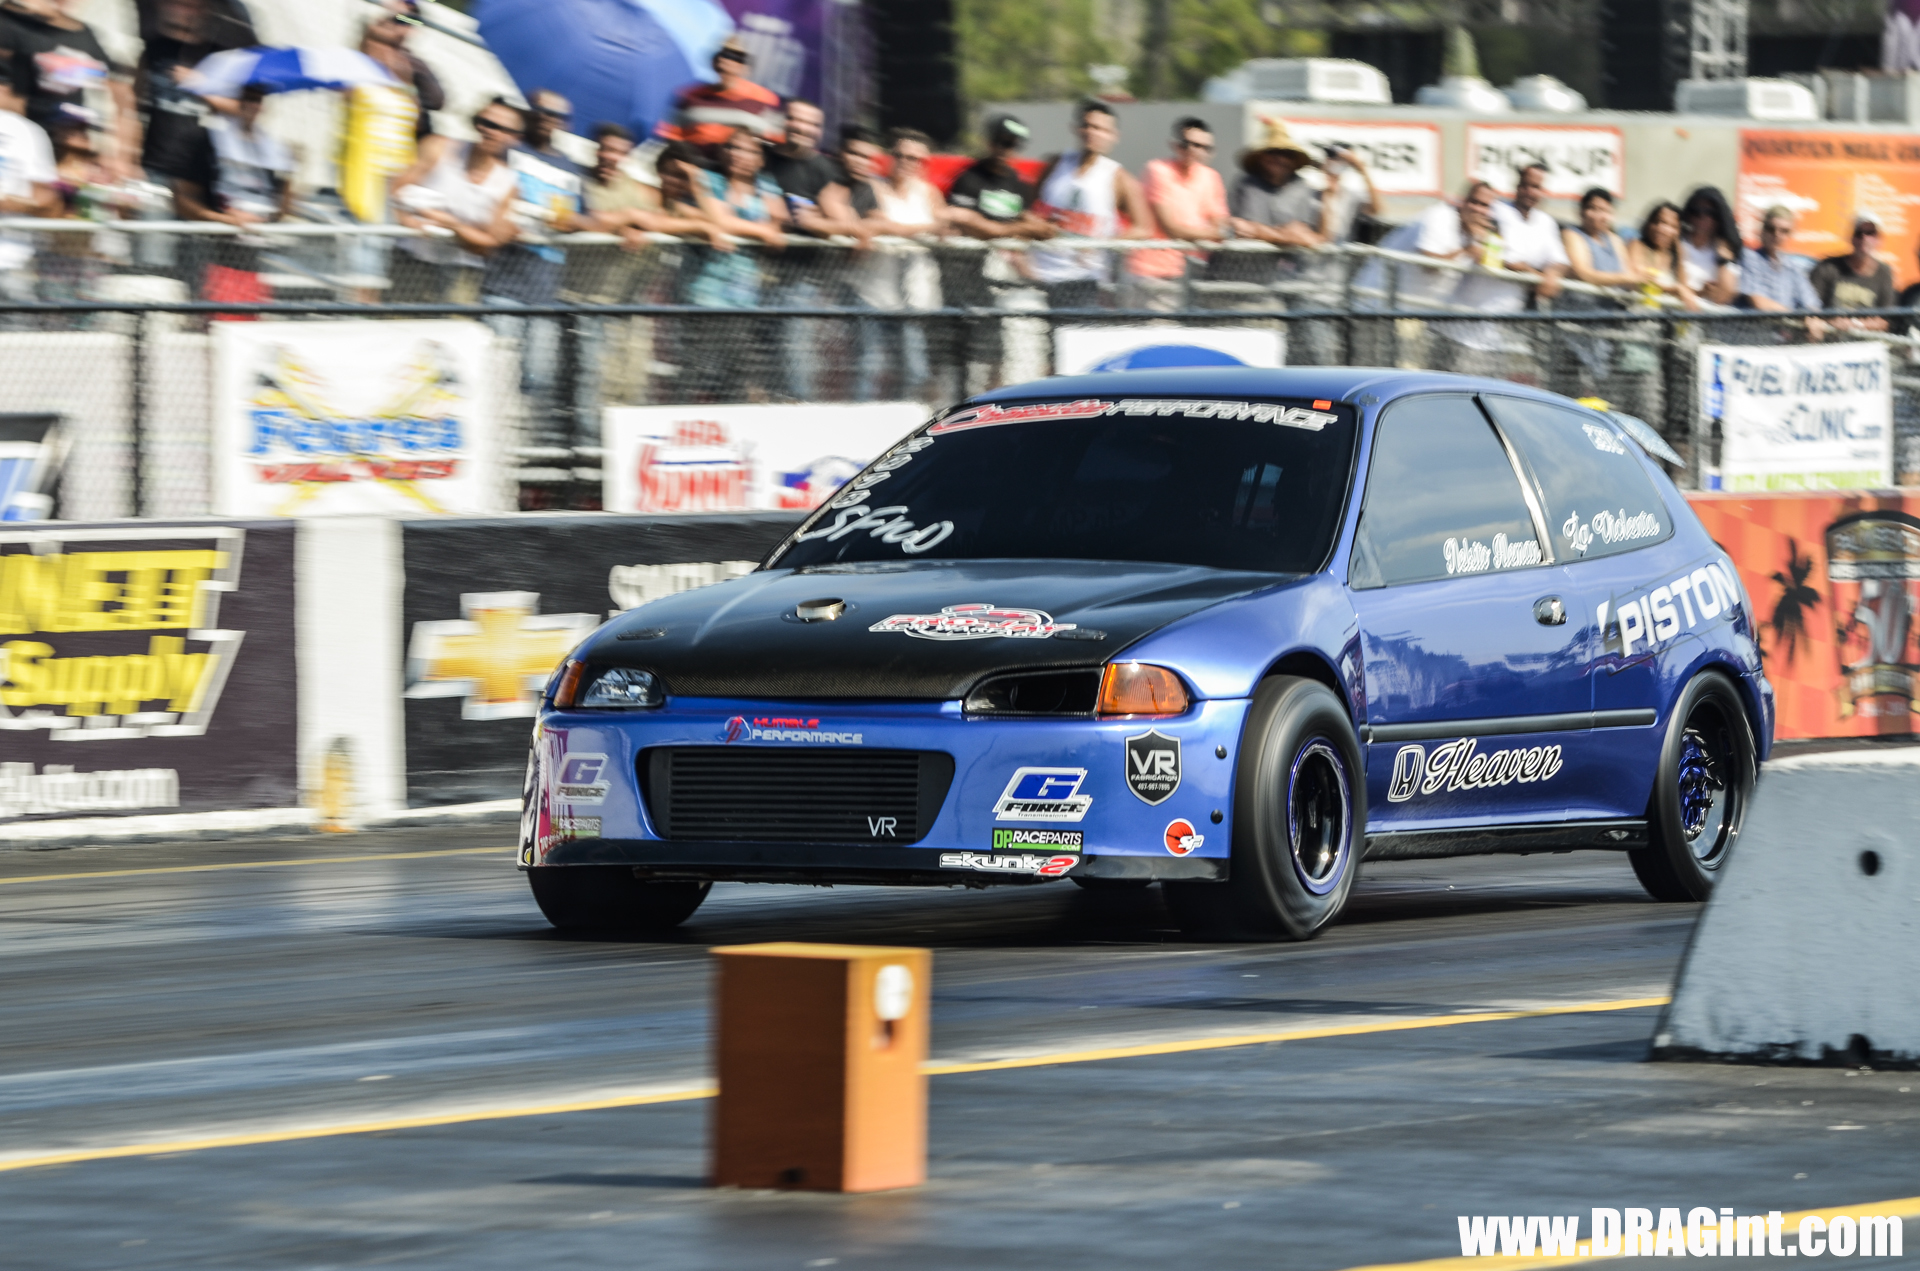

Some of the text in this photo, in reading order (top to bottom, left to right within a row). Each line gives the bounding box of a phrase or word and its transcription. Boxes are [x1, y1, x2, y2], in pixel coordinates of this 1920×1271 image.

[1104, 398, 1338, 432] PERFORMANCE
[0, 635, 221, 716] Supply
[753, 717, 820, 729] HUMBLE
[751, 728, 863, 745] PERFORMANCE
[1130, 748, 1177, 776] VR
[1421, 737, 1563, 795] Heaven
[1004, 802, 1086, 813] FORCE
[867, 815, 898, 837] VR
